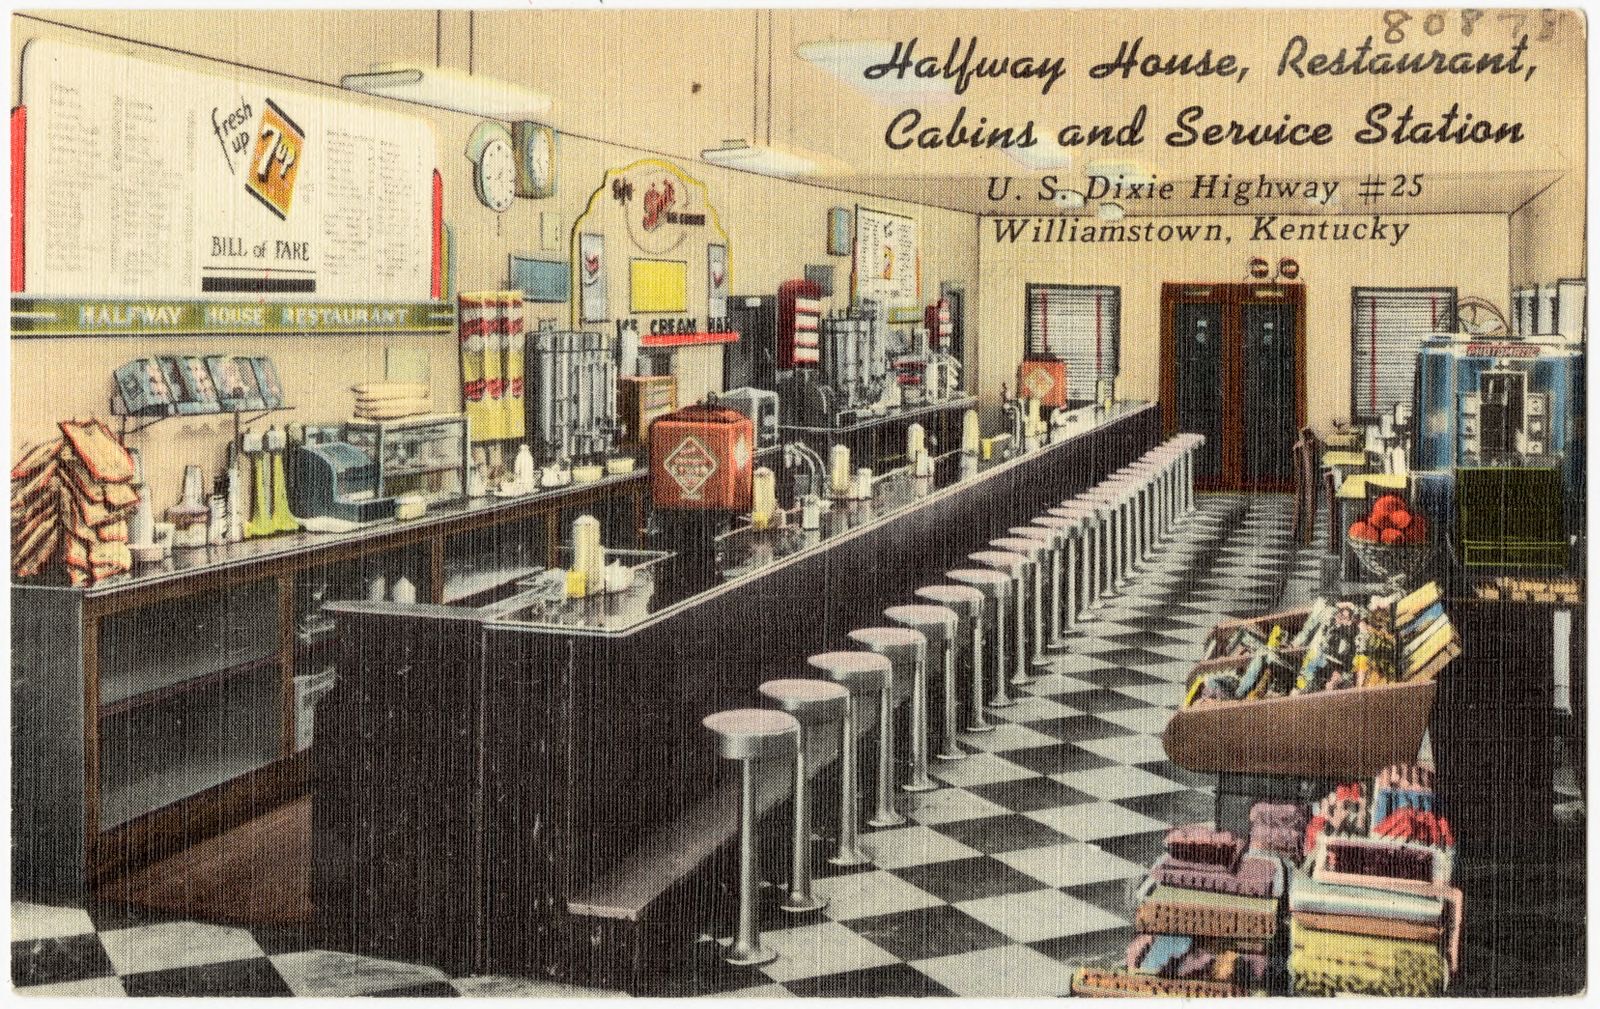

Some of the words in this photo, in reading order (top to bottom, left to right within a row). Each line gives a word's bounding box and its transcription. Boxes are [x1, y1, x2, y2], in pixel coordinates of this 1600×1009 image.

[212, 96, 253, 175] fresh
[232, 131, 250, 155] up
[211, 236, 248, 258] BILL
[252, 242, 267, 259] of
[275, 240, 310, 262] FARE
[79, 304, 183, 329] HALFWAY
[204, 304, 263, 328] HOUSE
[280, 305, 409, 328] RESTAURANT
[650, 318, 697, 336] CREAM
